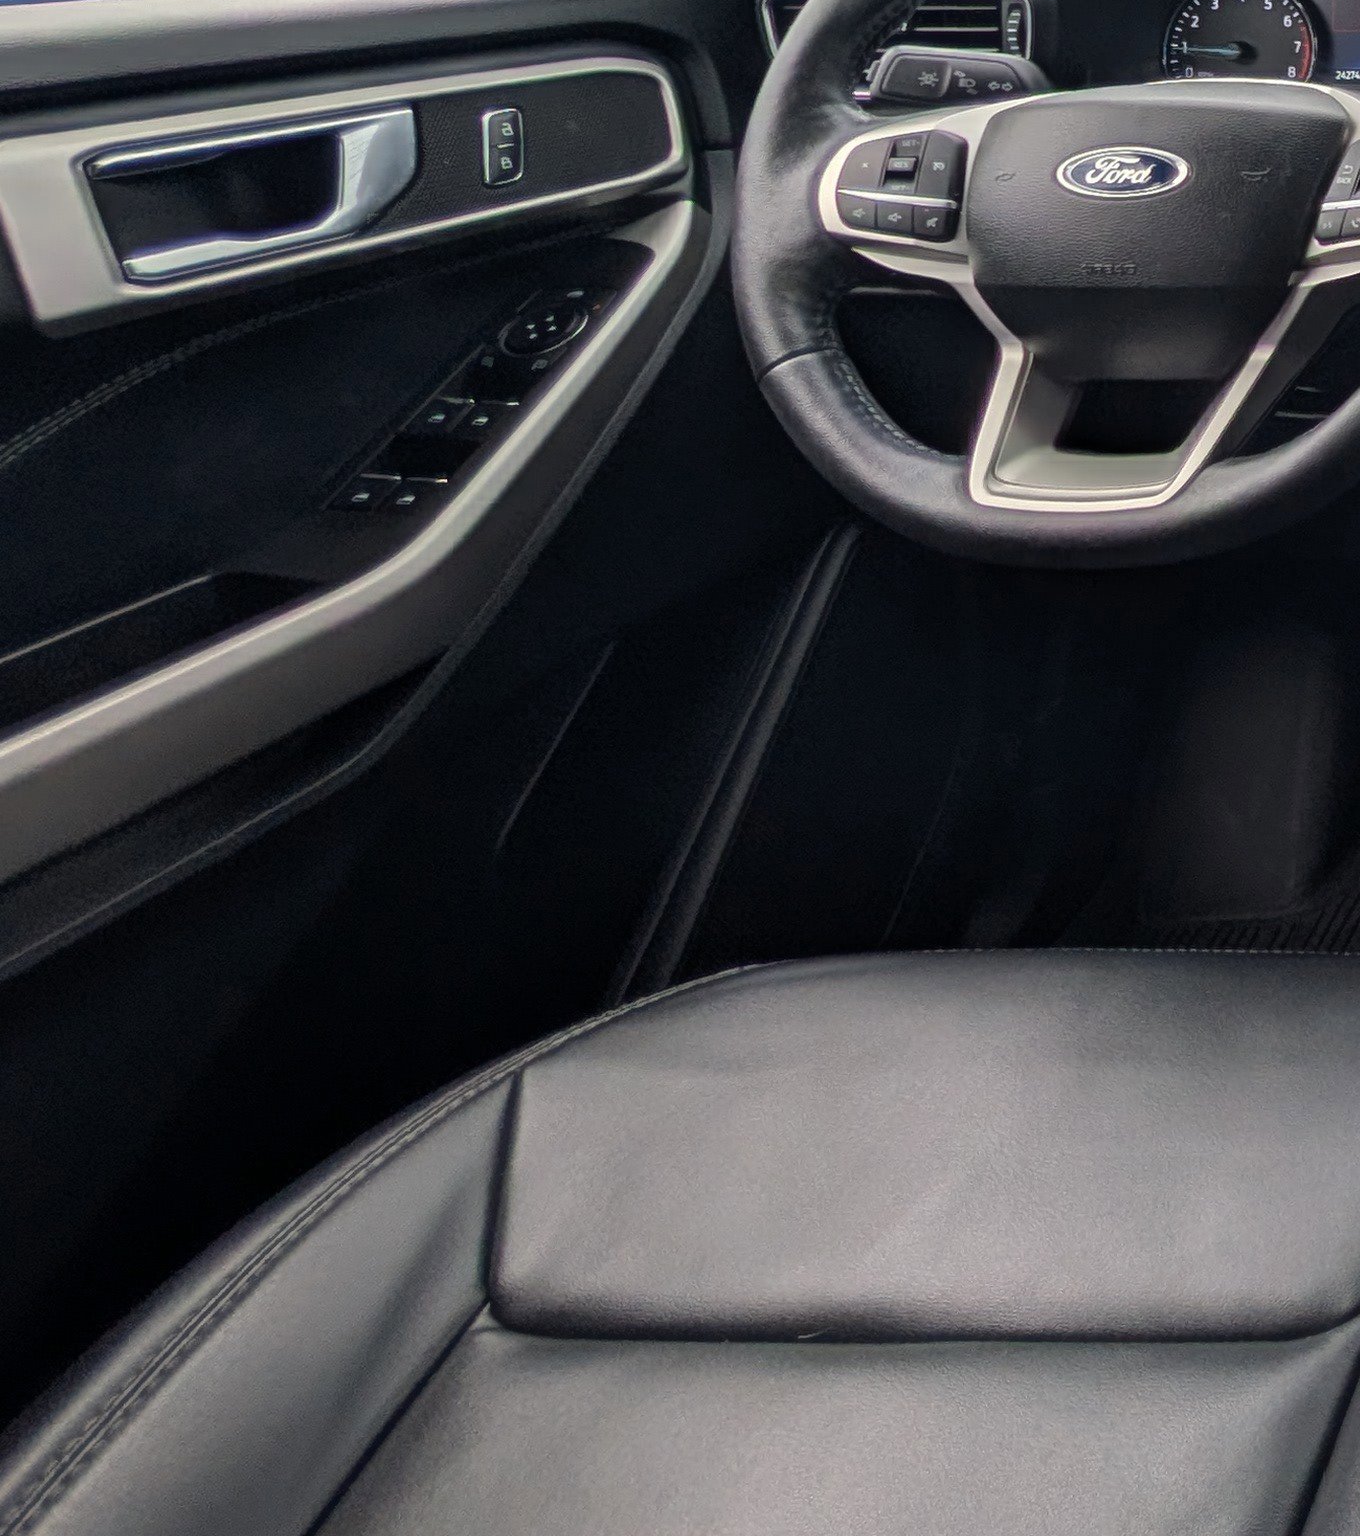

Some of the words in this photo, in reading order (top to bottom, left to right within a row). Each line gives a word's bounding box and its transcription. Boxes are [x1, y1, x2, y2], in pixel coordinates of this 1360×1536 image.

[1190, 15, 1200, 28] 2
[1283, 15, 1292, 27] 6
[1293, 41, 1301, 53] 7
[1287, 66, 1296, 78] 8
[1085, 154, 1157, 184] Ford
